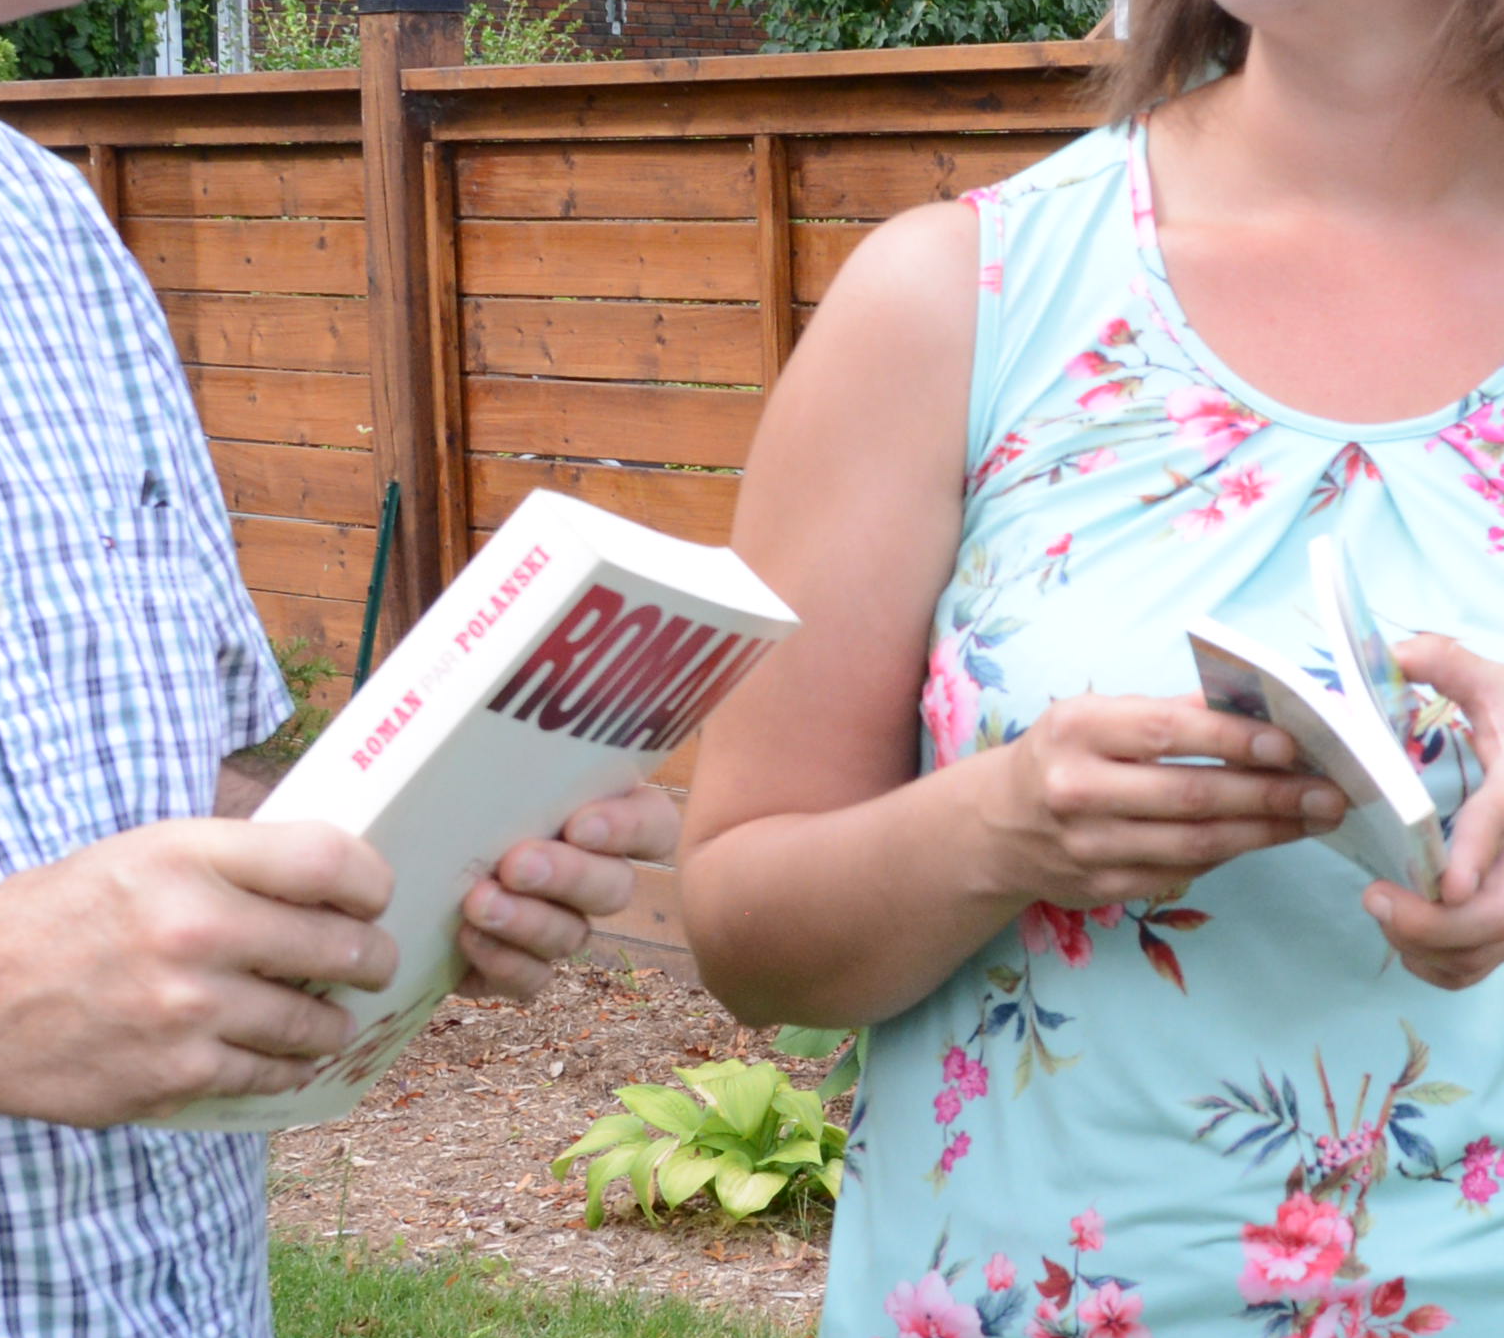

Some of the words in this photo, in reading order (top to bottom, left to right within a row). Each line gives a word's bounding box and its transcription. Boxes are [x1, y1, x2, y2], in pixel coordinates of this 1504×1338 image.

[351, 689, 424, 772] ROMAN
[421, 652, 460, 695] PAR
[452, 544, 552, 655] POLANSKI
[486, 583, 778, 752] ROMAN
